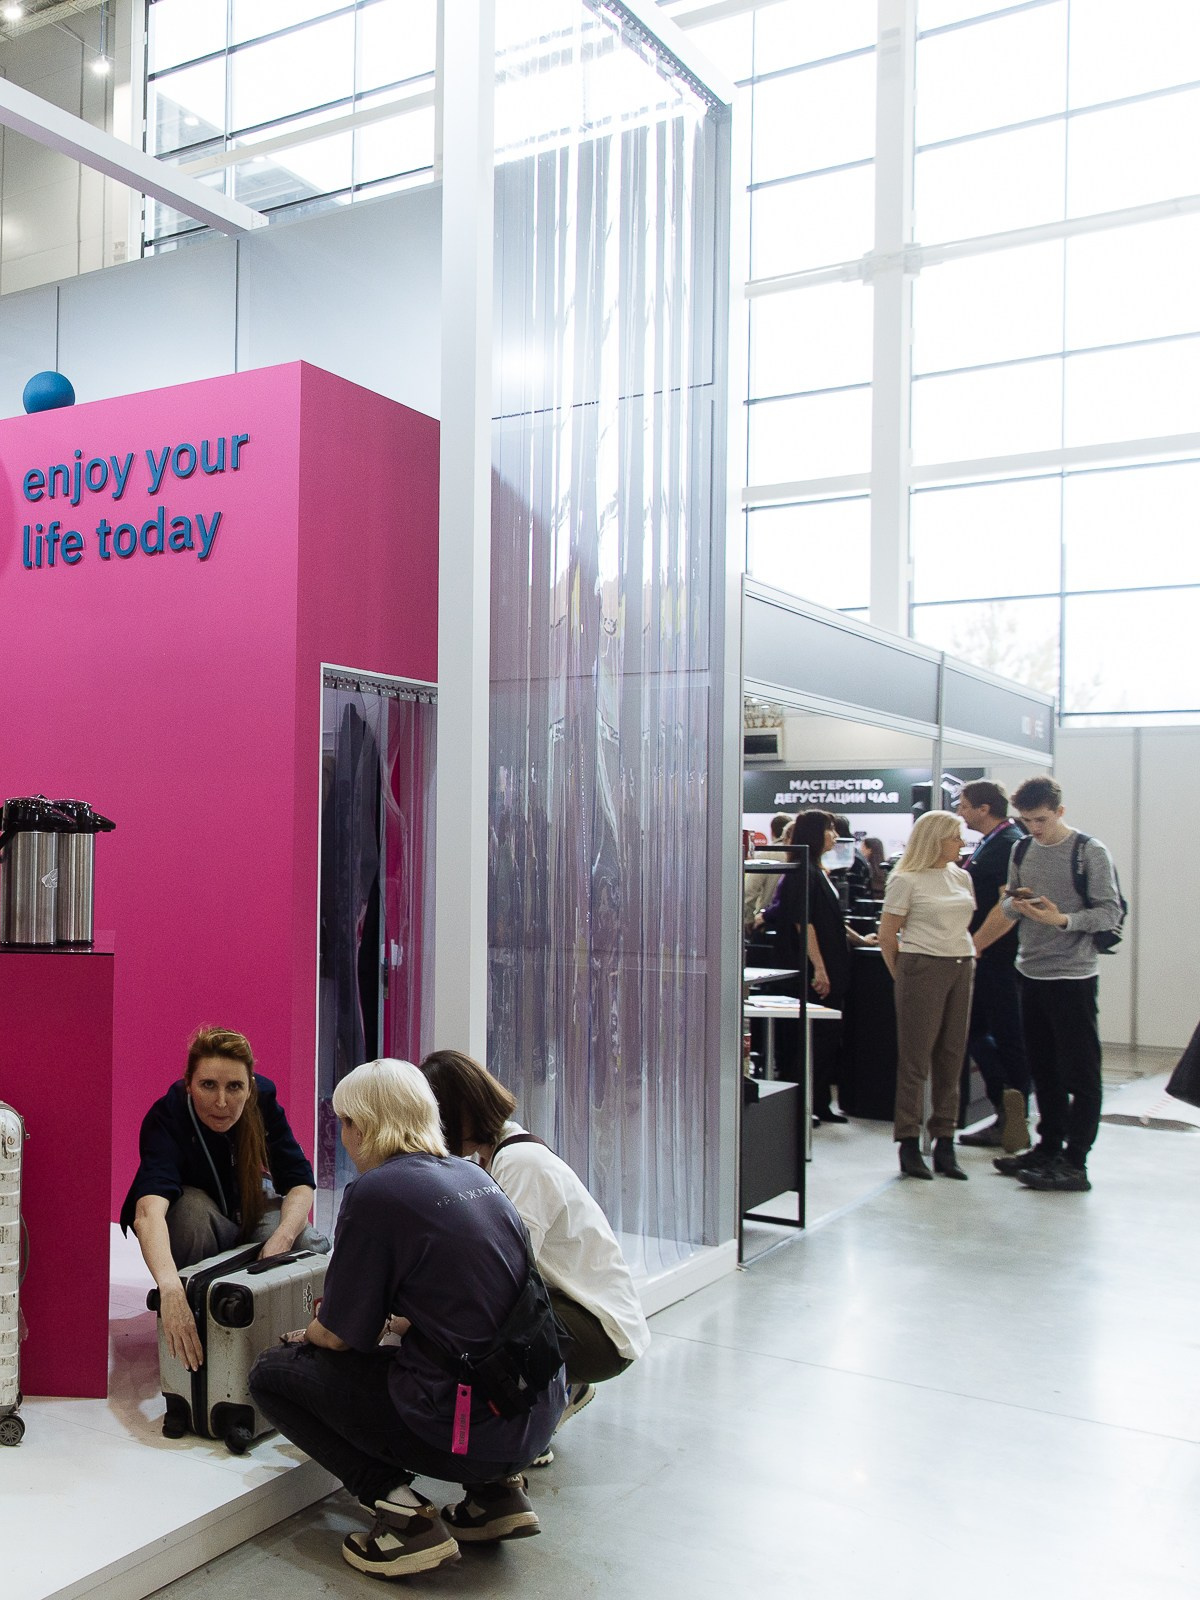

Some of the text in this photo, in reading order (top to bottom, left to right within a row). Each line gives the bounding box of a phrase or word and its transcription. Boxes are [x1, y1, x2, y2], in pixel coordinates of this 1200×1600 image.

[23, 433, 250, 507] enjoy your
[22, 506, 222, 569] life today
[774, 791, 900, 805] ДЕГУСТАЦИИ ЧАЯ
[789, 778, 884, 790] МАСТЕРСТВО
